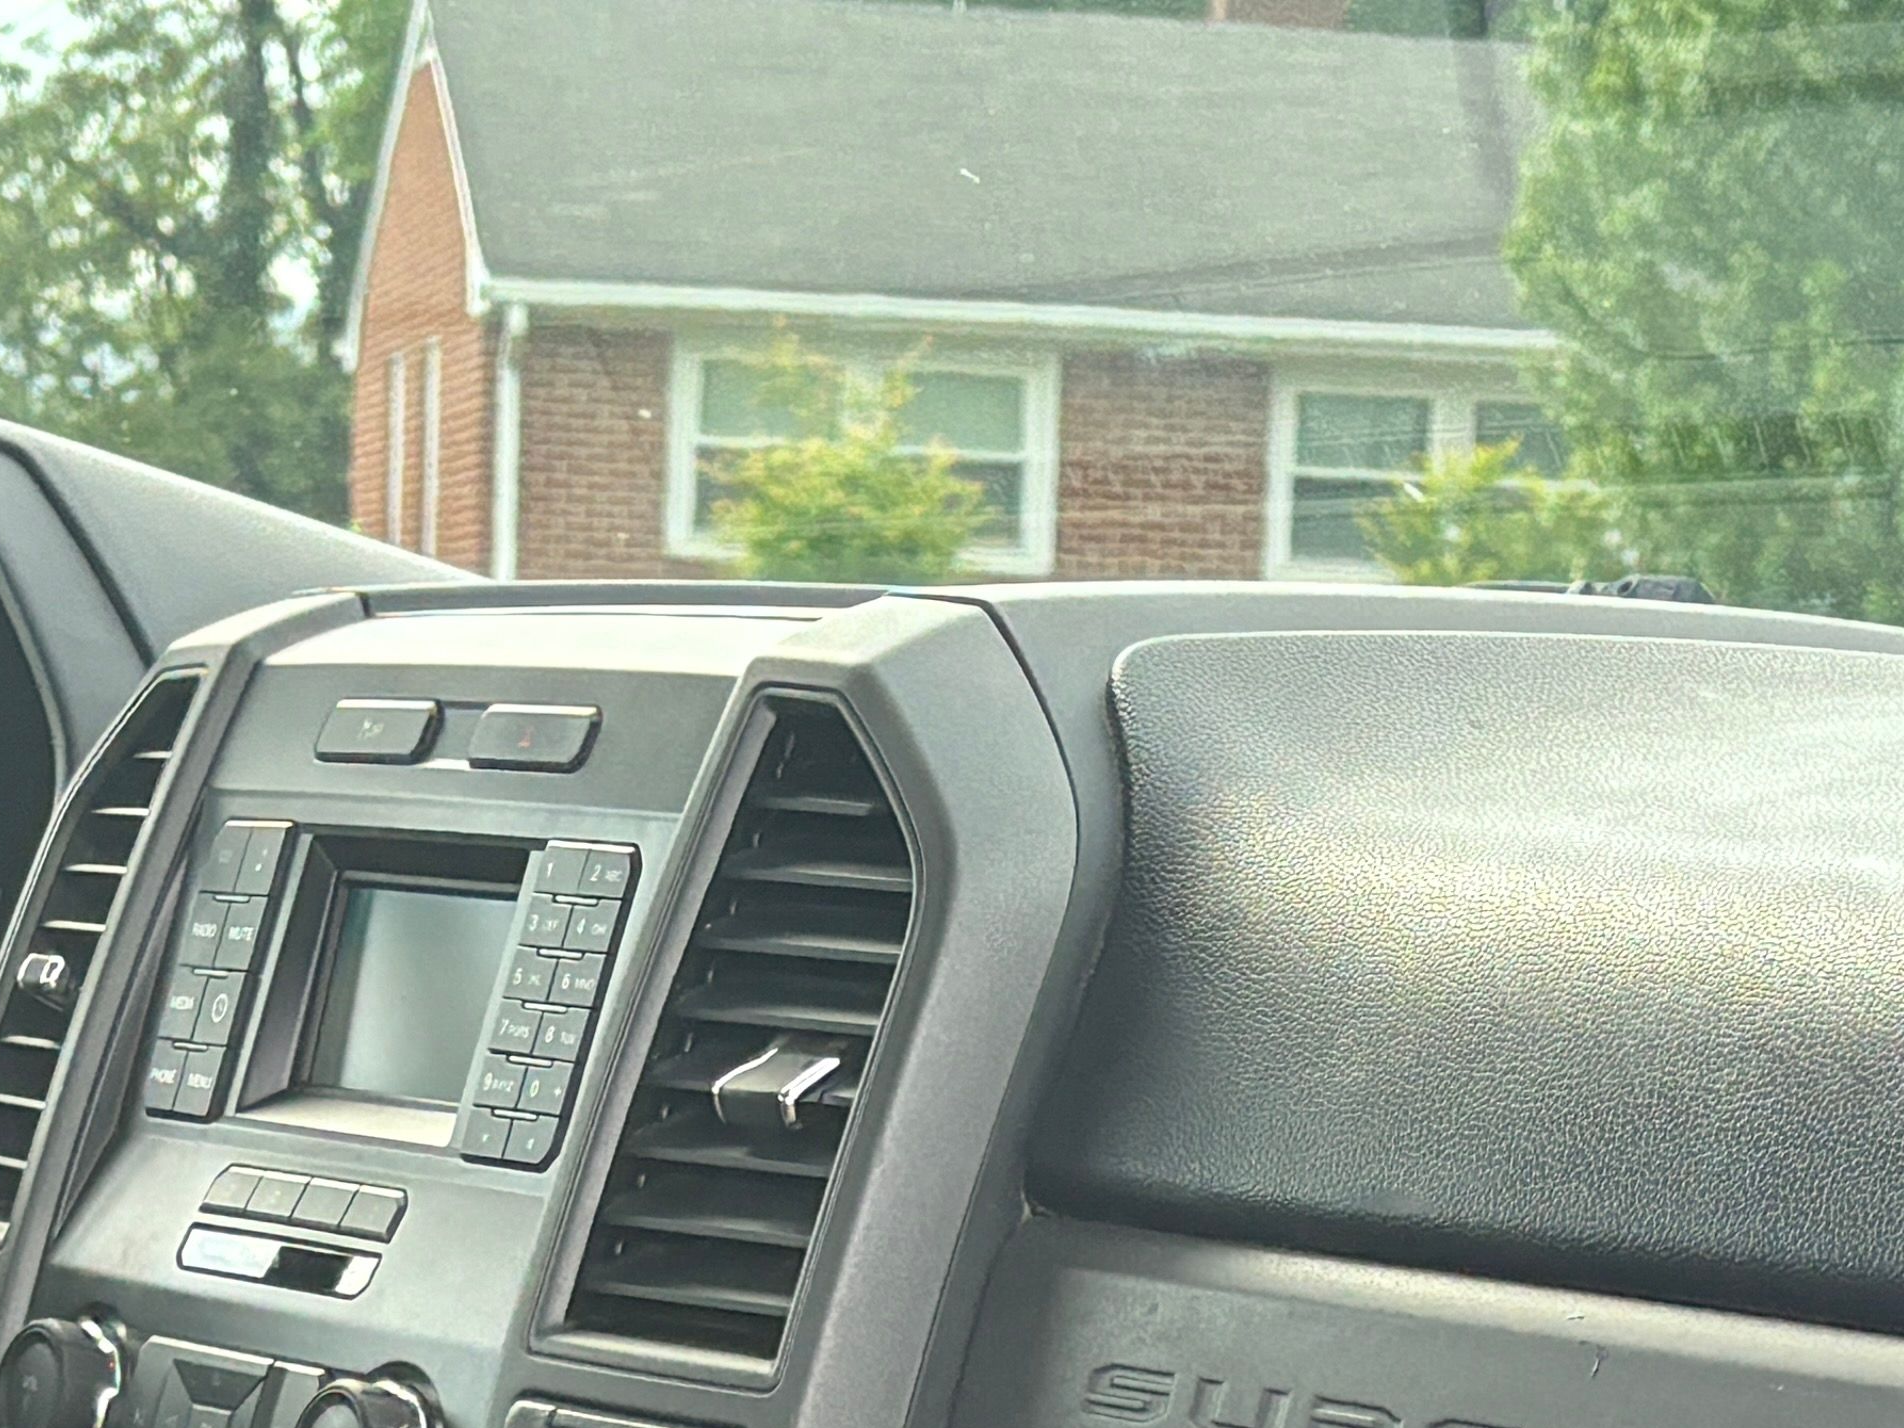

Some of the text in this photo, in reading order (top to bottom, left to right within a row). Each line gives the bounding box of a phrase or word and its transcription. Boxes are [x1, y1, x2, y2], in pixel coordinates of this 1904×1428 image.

[547, 862, 554, 878] 1
[590, 864, 602, 882] 2
[529, 914, 539, 931] 3
[513, 968, 523, 985] 5
[561, 973, 572, 990] 6
[545, 1026, 556, 1043] 8
[483, 1072, 493, 1092] 9
